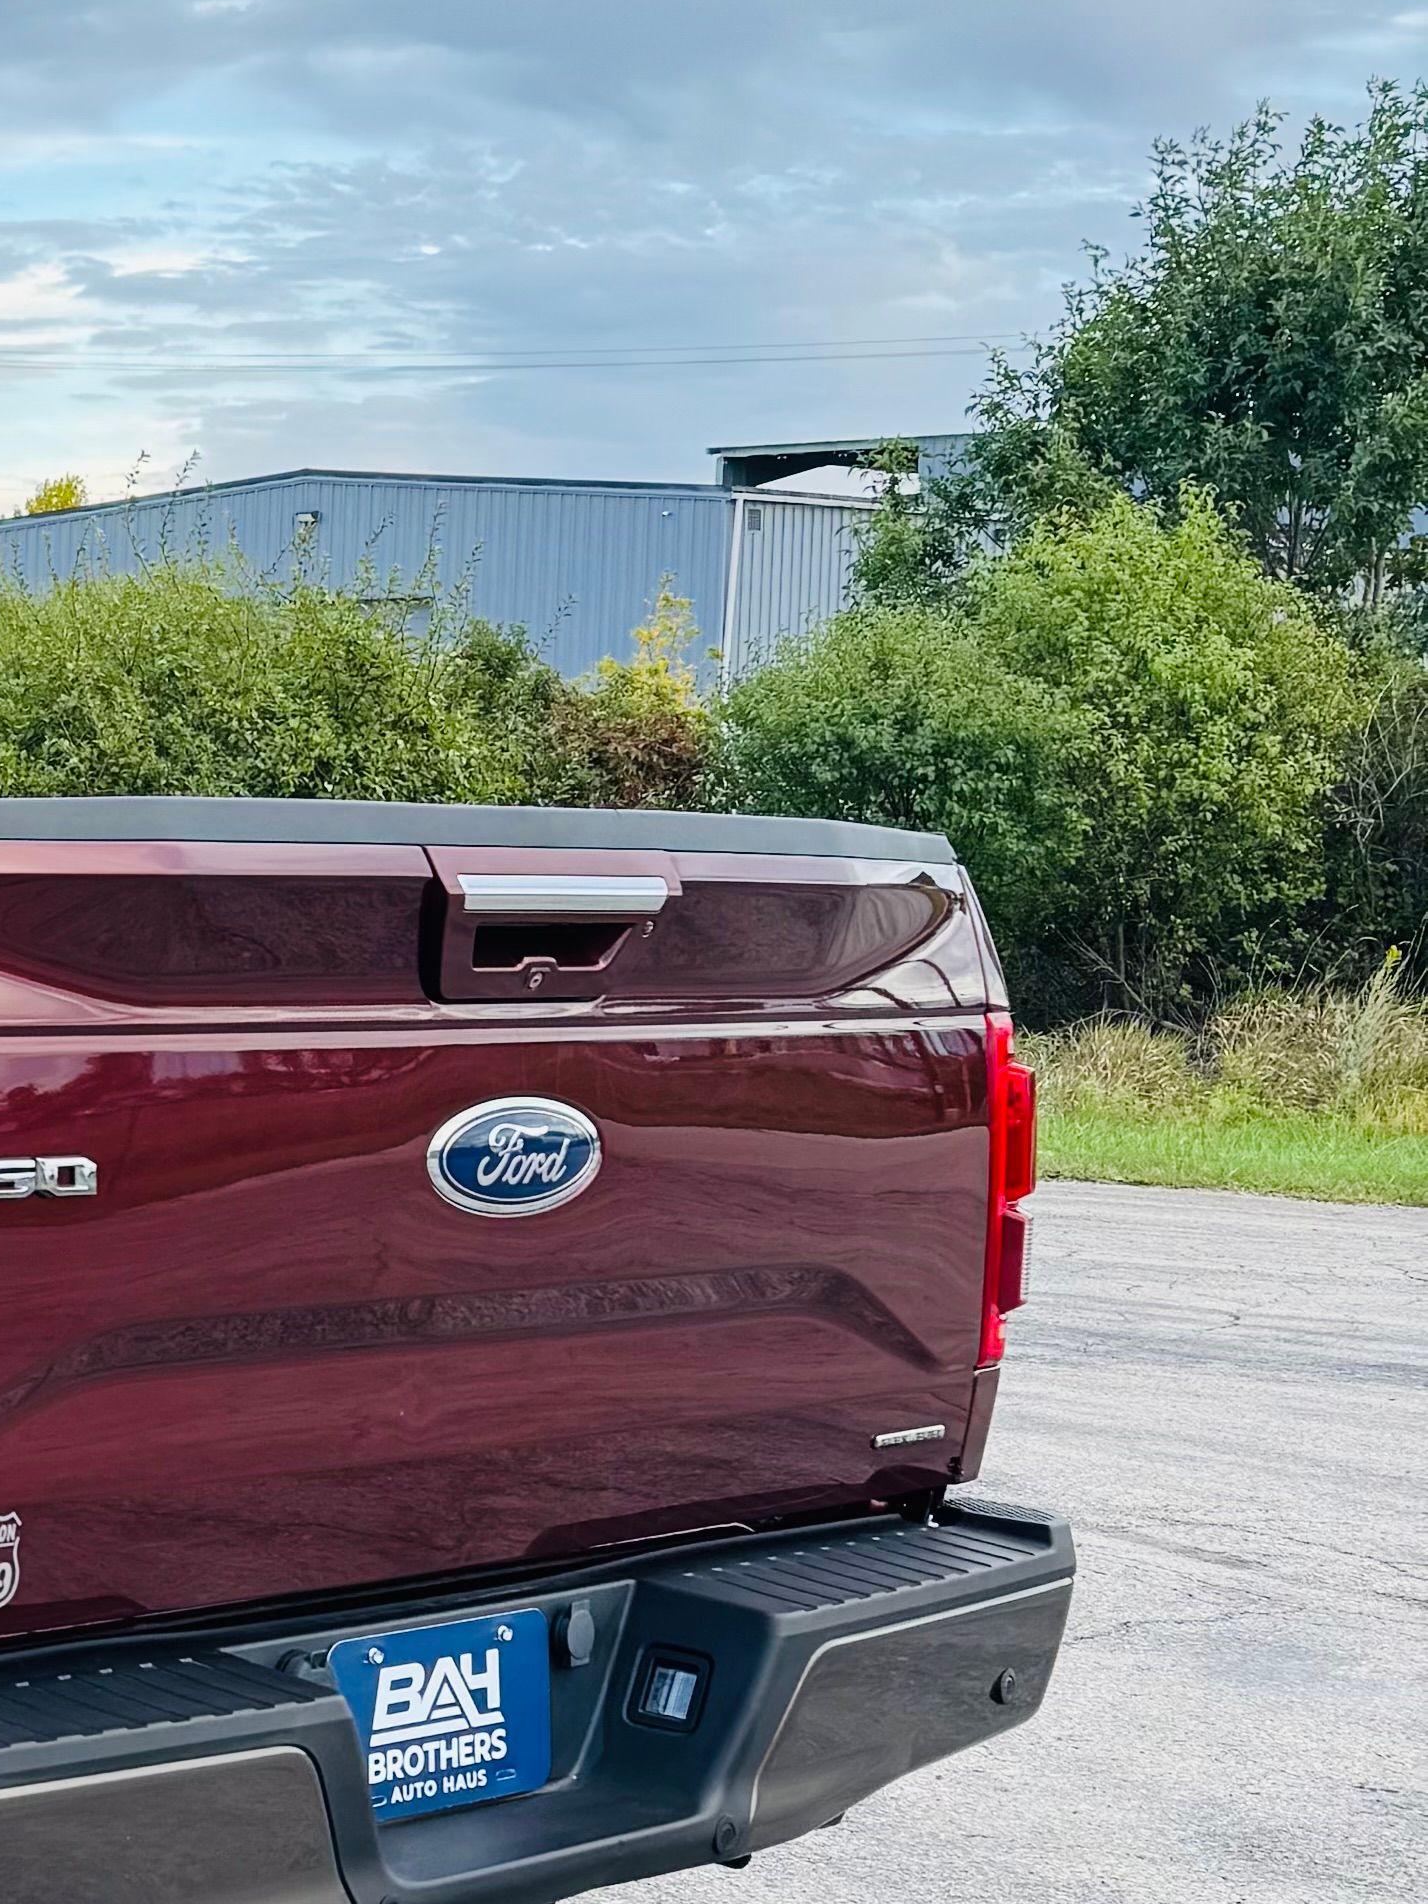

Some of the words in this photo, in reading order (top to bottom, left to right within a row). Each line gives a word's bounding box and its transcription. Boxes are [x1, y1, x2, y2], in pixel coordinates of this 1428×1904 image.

[477, 1122, 571, 1187] Ford
[367, 1728, 508, 1785] BROTHERS
[390, 1779, 438, 1805] AUTO
[443, 1769, 488, 1794] HAUS
